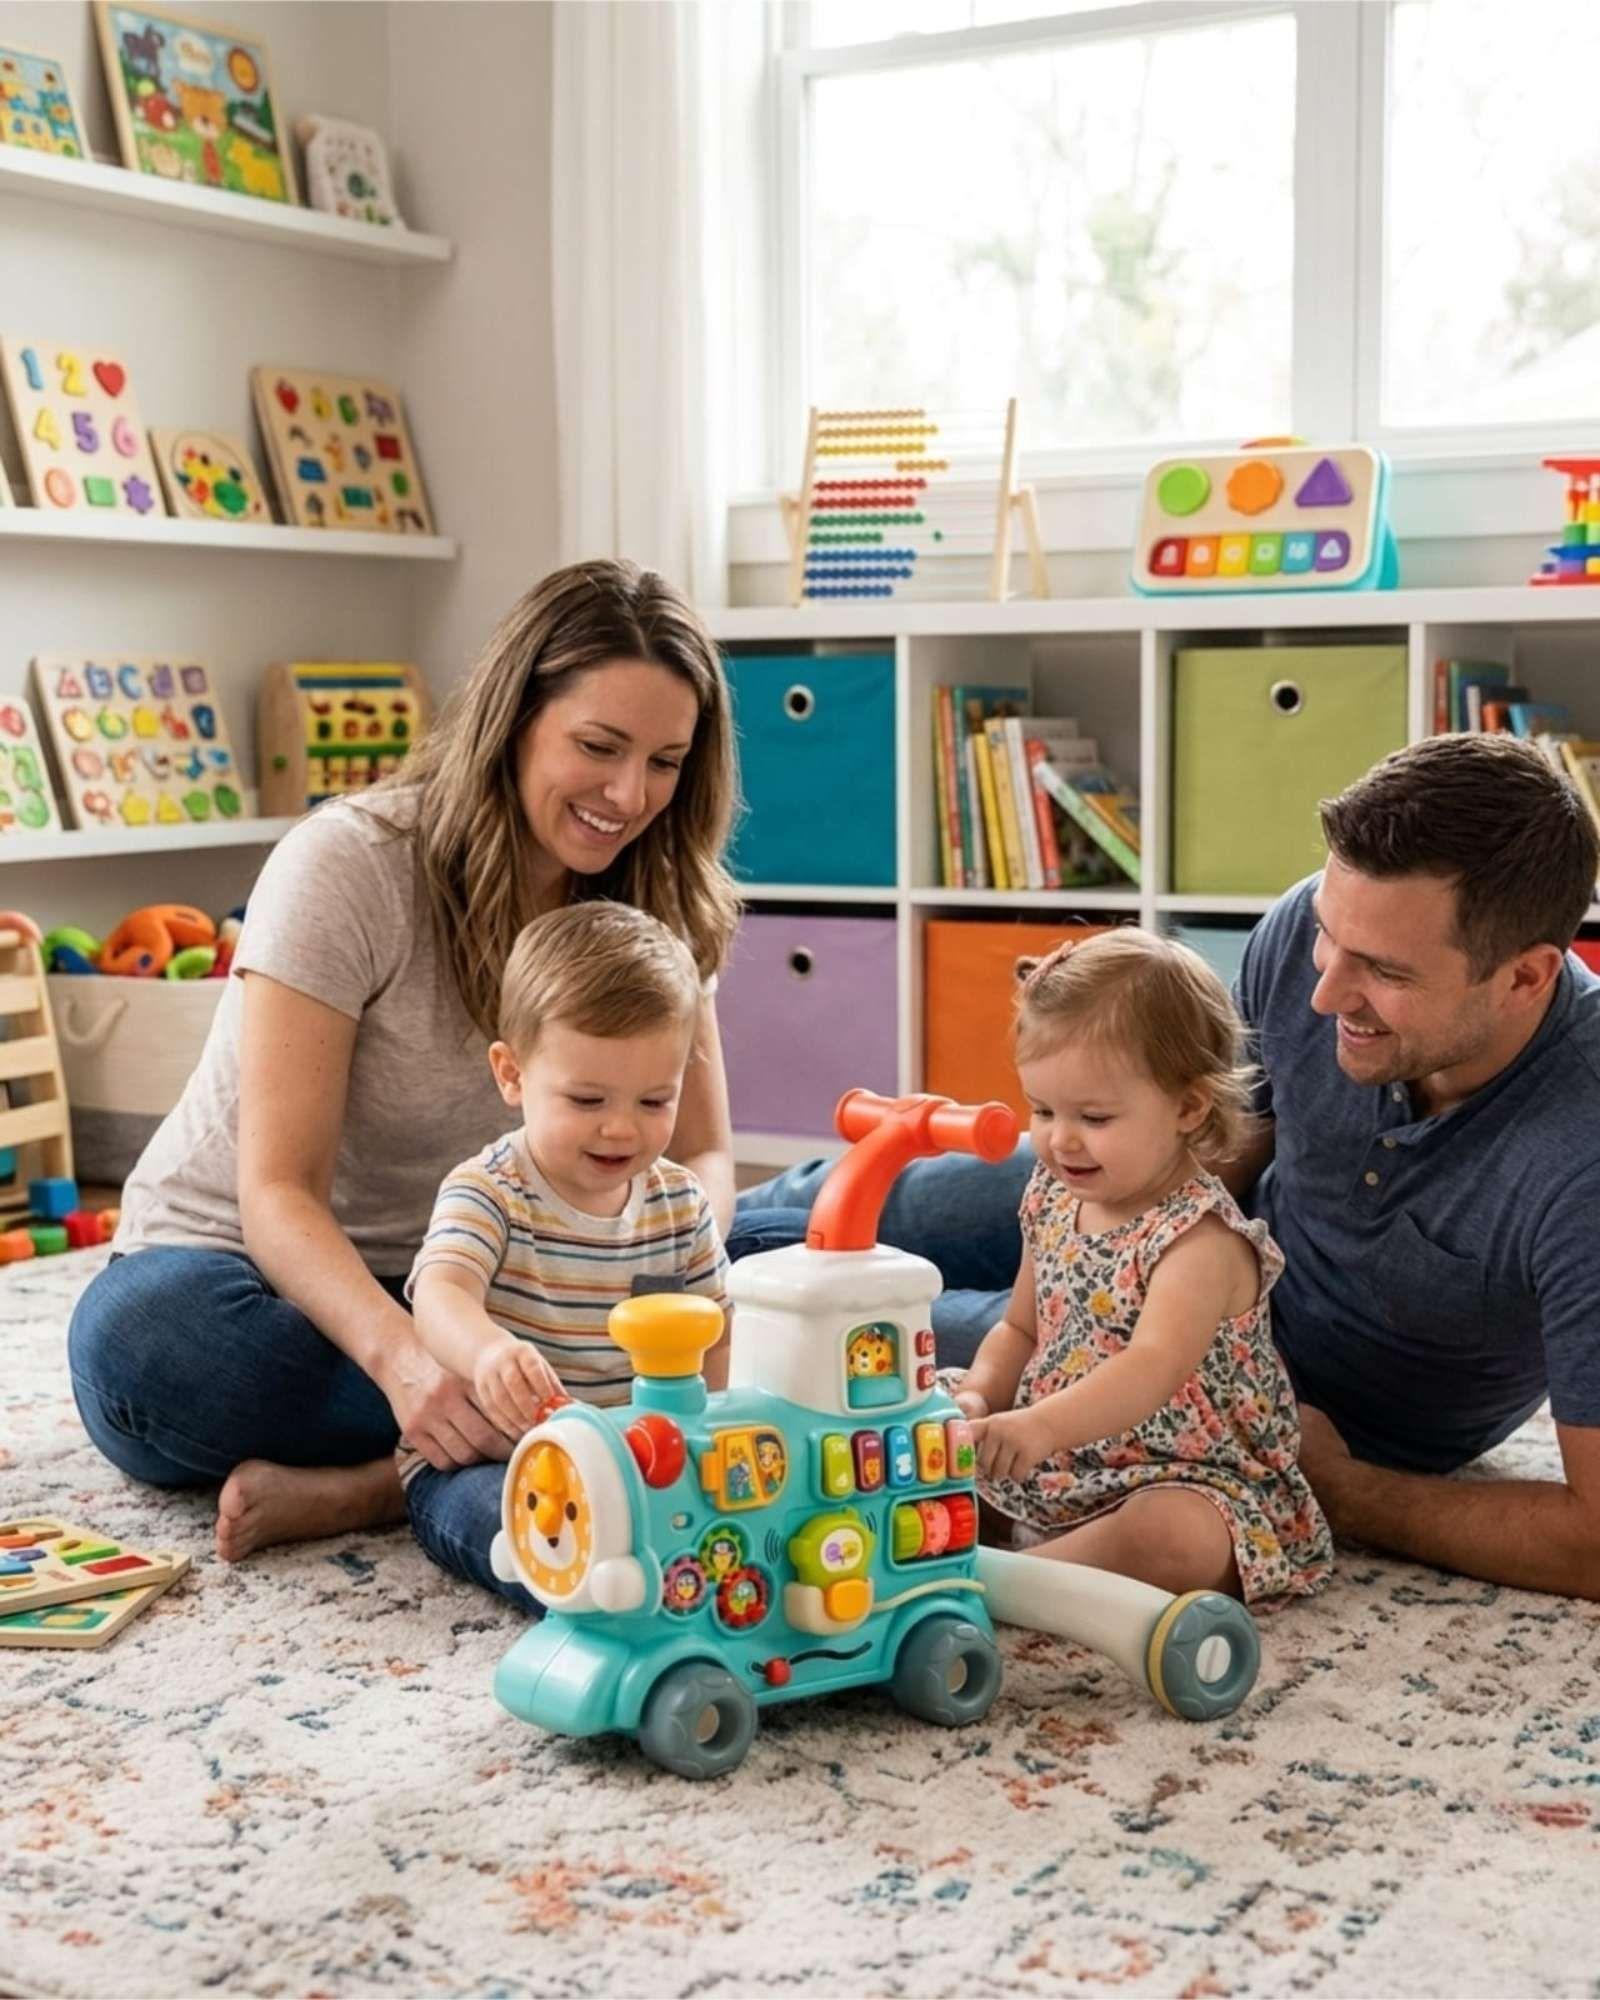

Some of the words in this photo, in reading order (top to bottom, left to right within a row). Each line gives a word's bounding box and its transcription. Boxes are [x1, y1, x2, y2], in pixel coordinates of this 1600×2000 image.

[20, 347, 43, 391] 1
[56, 352, 88, 398] 2
[34, 407, 61, 452] 4
[72, 411, 99, 454] 5
[112, 415, 140, 459] 6
[117, 663, 142, 700] C
